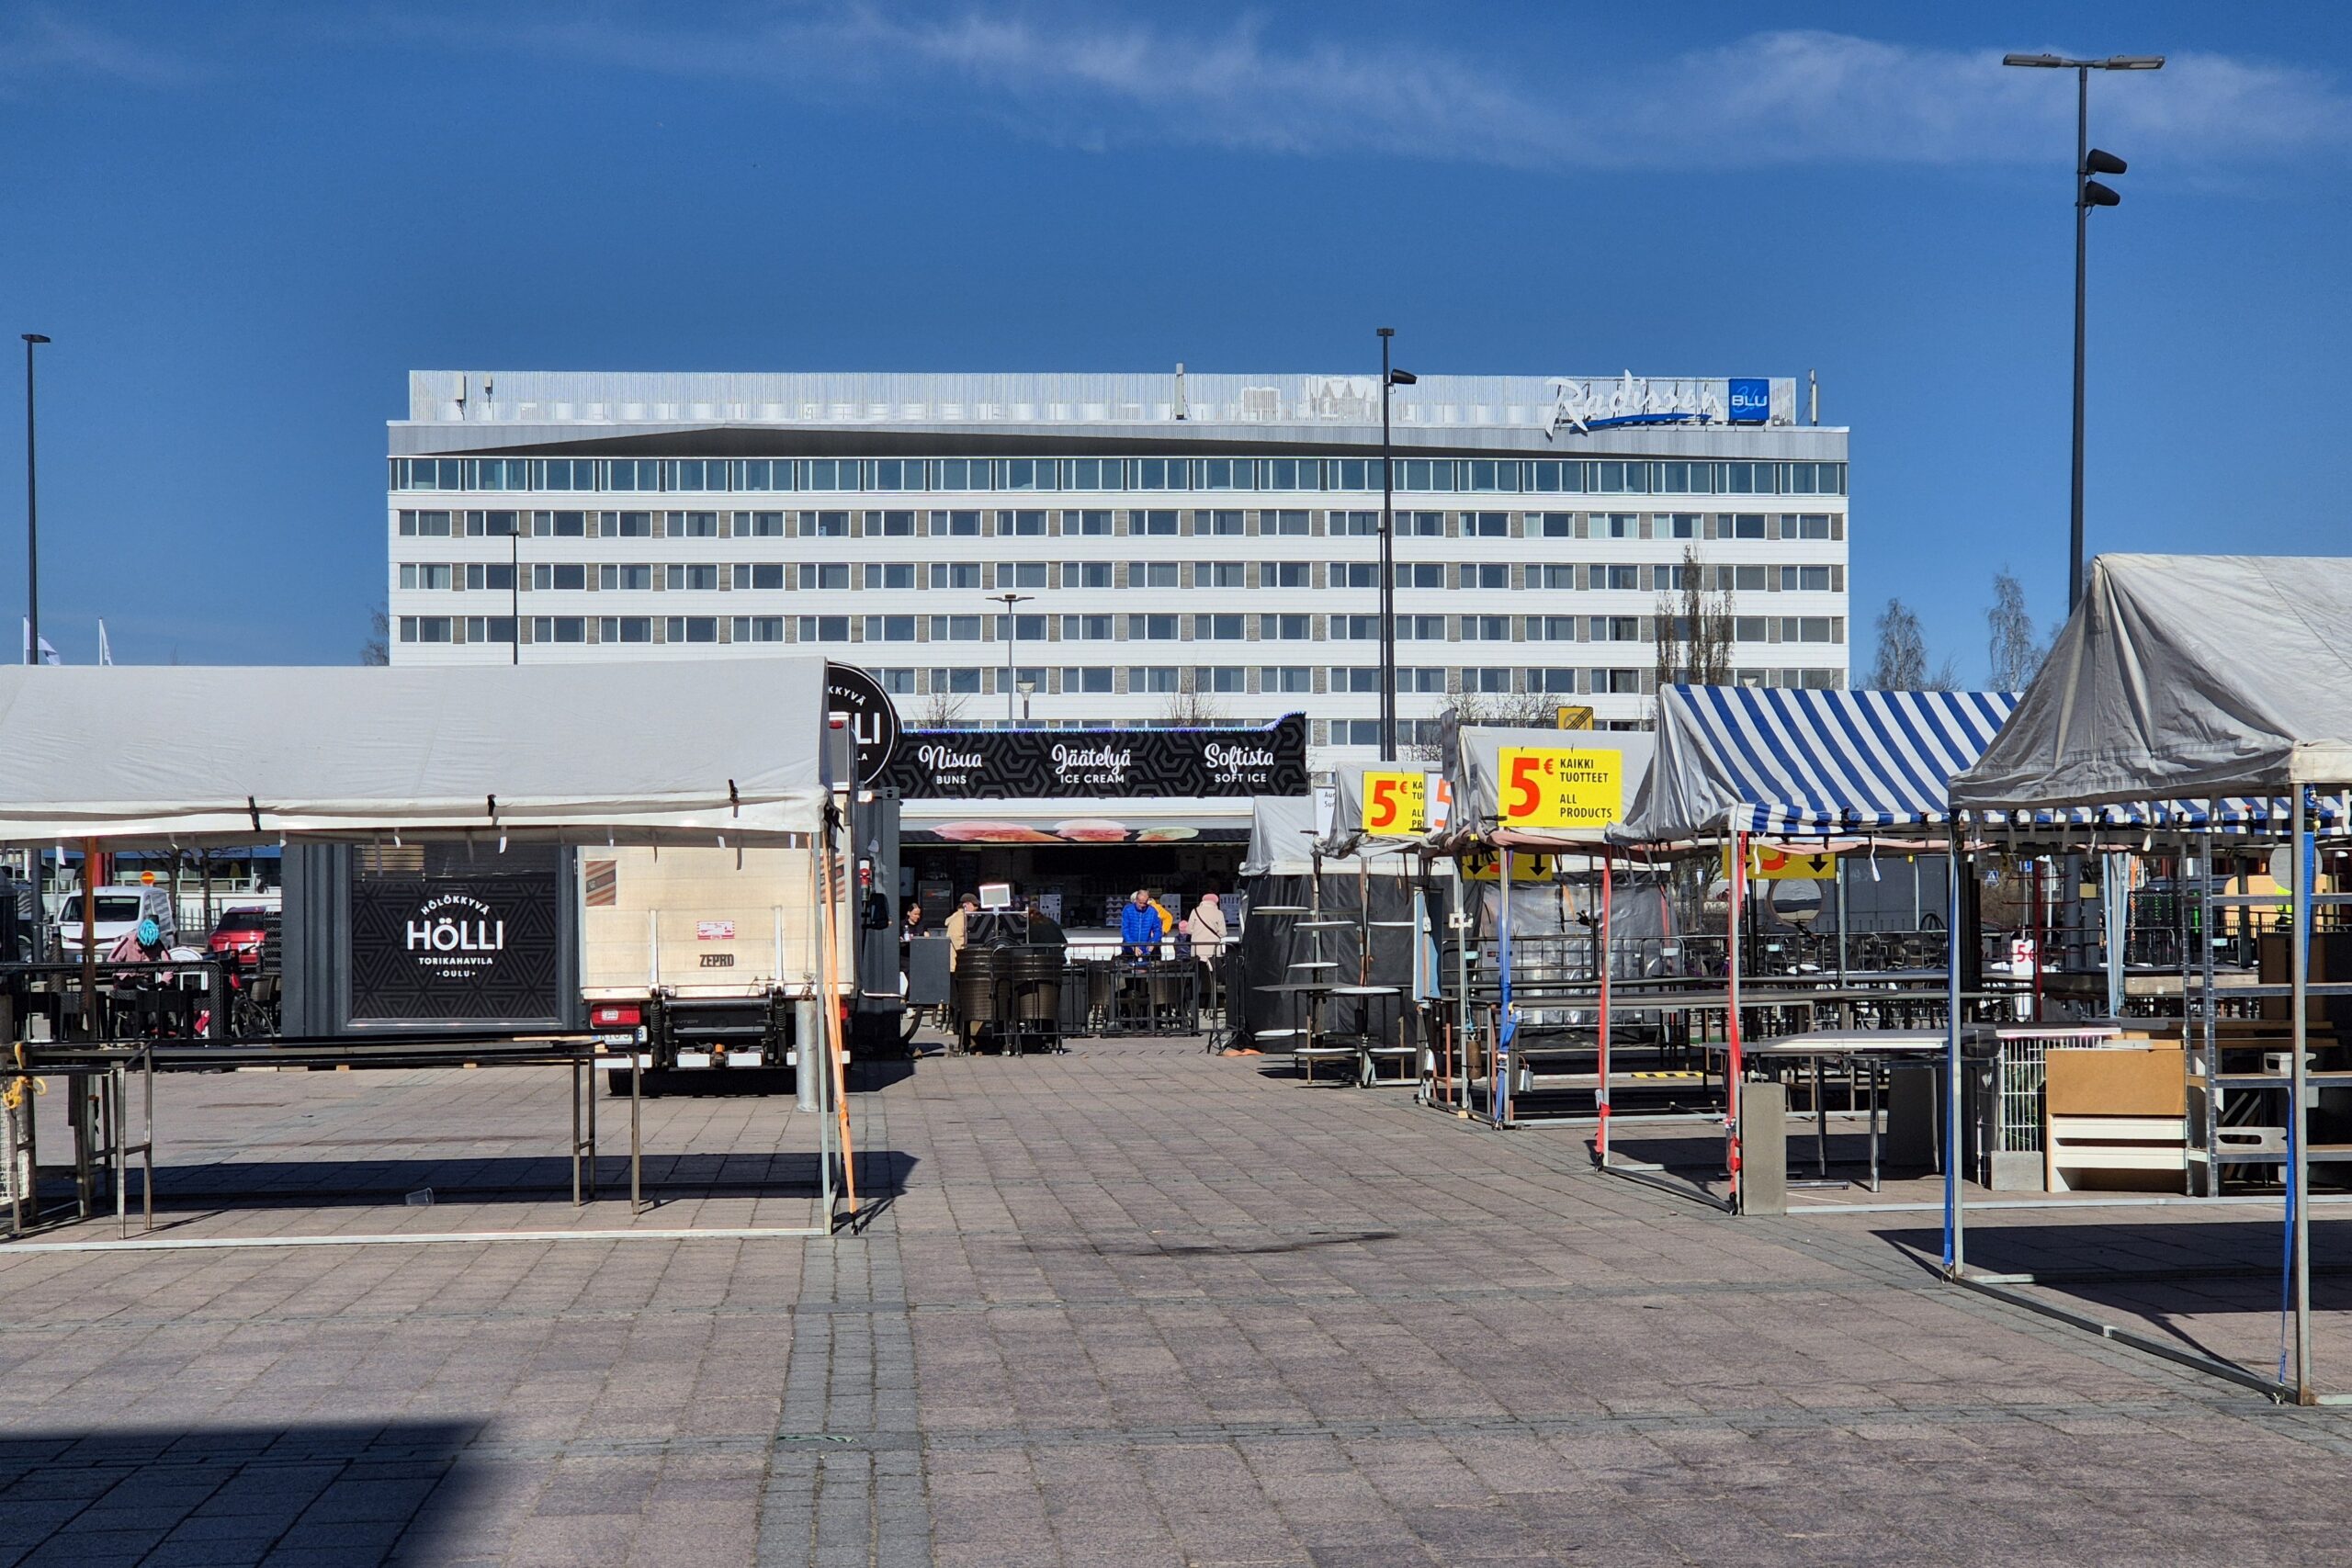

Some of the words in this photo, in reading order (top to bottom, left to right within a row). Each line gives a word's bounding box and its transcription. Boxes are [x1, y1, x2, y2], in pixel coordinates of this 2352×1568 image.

[1545, 368, 1724, 437] Radisson
[1732, 395, 1768, 406] BLU
[828, 685, 866, 706] KKYVÄ
[918, 745, 983, 770] Nisua
[1051, 743, 1131, 775] Jäätelyä
[1204, 742, 1274, 774] Softista
[1559, 758, 1594, 769] KAIKKI
[936, 775, 967, 784] BUNS
[1060, 774, 1080, 784] ICE
[1083, 774, 1125, 784] CREAM
[1215, 773, 1243, 783] SOFT
[1248, 773, 1267, 783] ICE
[1559, 772, 1609, 783] TUOTTEET
[1559, 794, 1577, 804] ALL
[1559, 807, 1612, 818] PRODUCTS
[420, 895, 491, 916] HÖLÖKKYVÄ
[407, 917, 503, 951] HÖLLI
[418, 957, 493, 965] TORIKAHAVILA
[699, 953, 735, 967] ZEPRO
